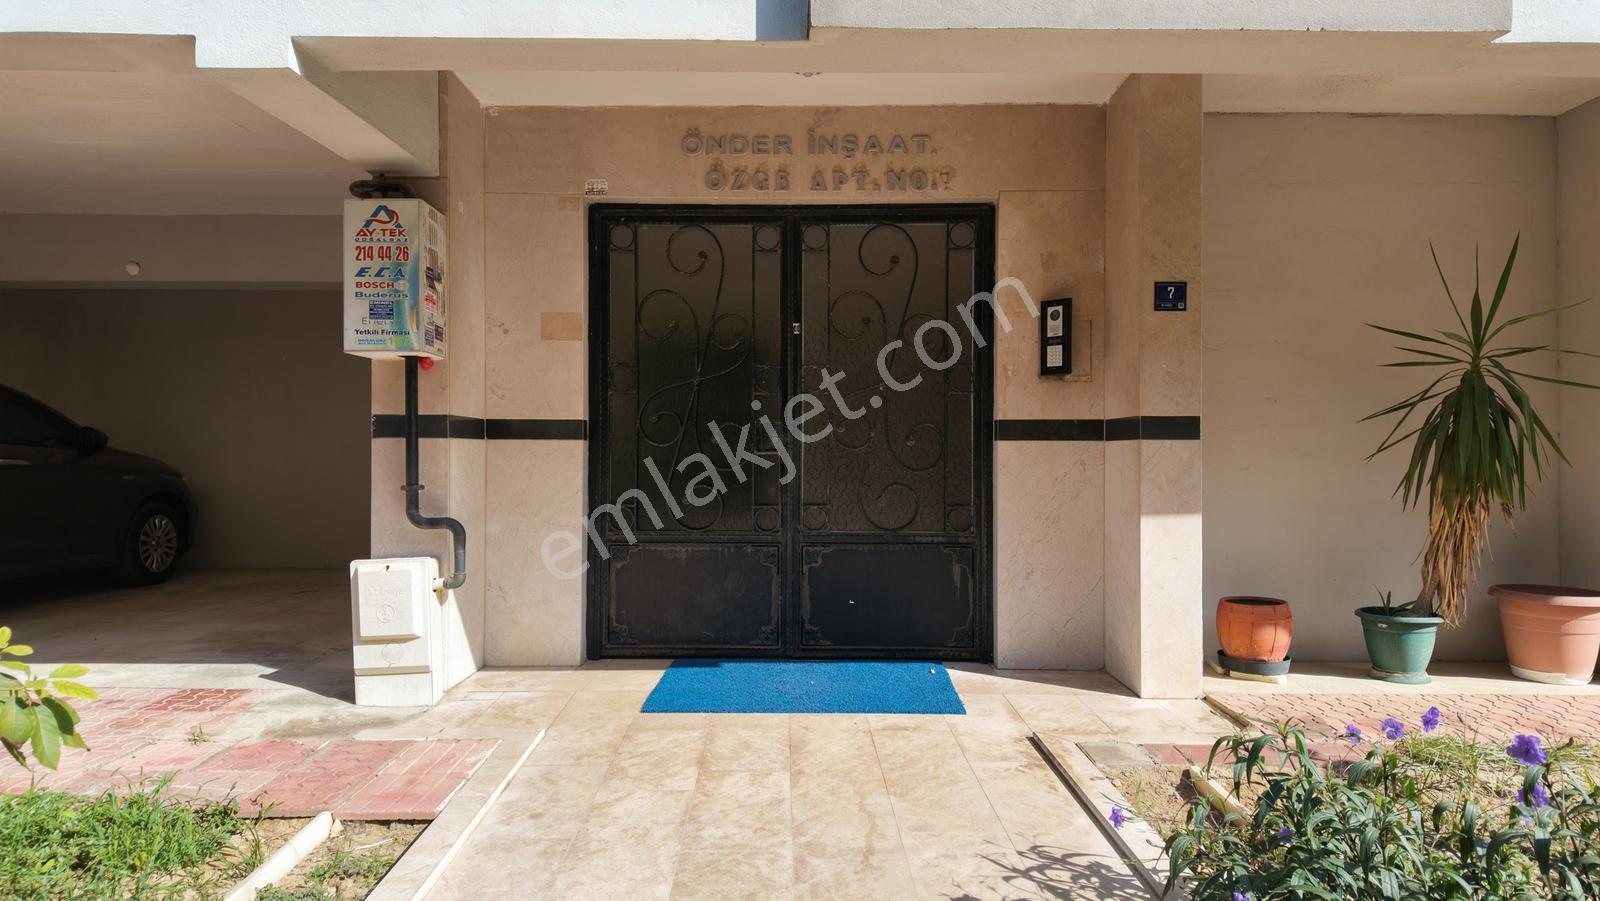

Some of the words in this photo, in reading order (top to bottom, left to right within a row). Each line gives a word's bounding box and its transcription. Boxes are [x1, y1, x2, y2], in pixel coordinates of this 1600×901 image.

[680, 127, 793, 156] ÖNDER
[703, 158, 792, 192] ÖZGE
[355, 245, 374, 262] 214
[377, 245, 392, 262] 44
[395, 245, 410, 262] 26
[355, 281, 395, 289] BOSCH
[1167, 286, 1176, 299] 7
[354, 328, 379, 336] Yetkili
[381, 328, 410, 336] Firması
